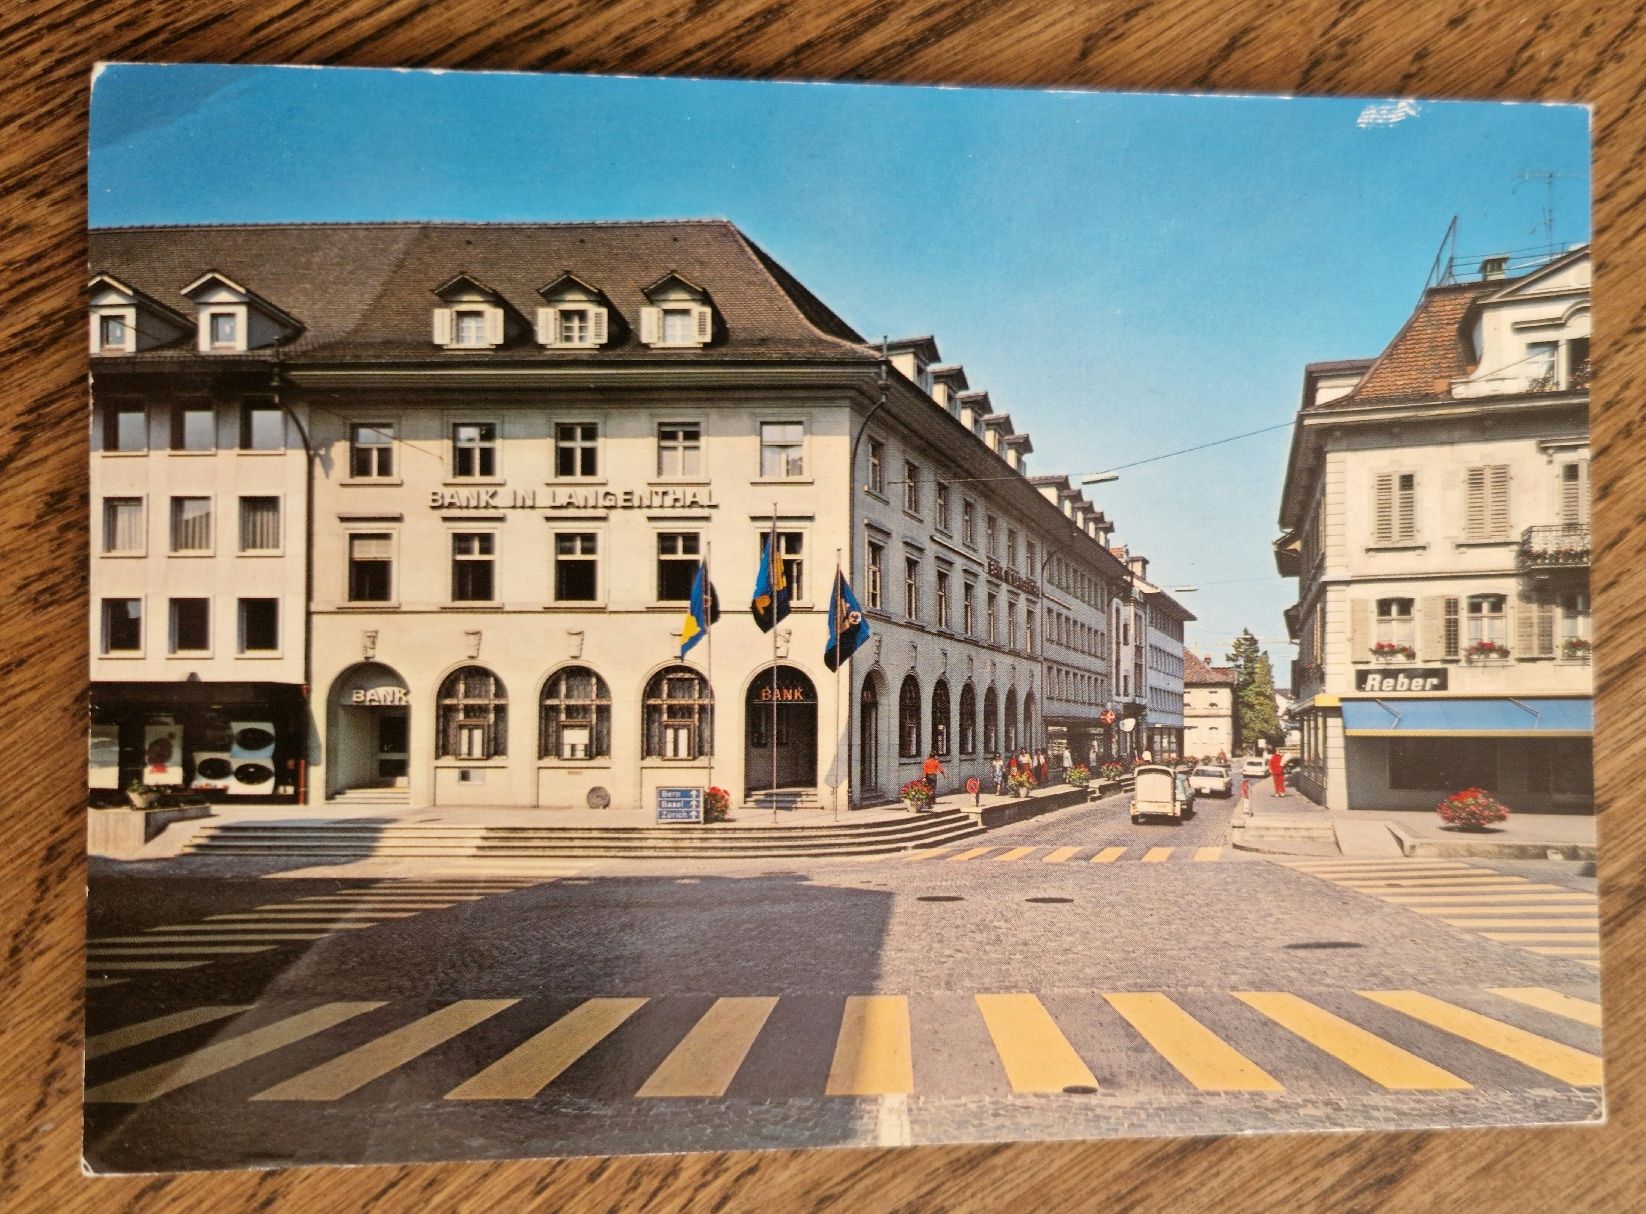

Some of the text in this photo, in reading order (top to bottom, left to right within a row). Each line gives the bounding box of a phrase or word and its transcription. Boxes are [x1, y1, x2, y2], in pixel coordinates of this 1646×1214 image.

[430, 489, 719, 509] BANK IN LANGENTHAL
[1365, 673, 1438, 691] Reber
[352, 687, 409, 704] BANK
[761, 688, 803, 700] BANK
[661, 790, 681, 798] Bern
[661, 800, 684, 808] Basel
